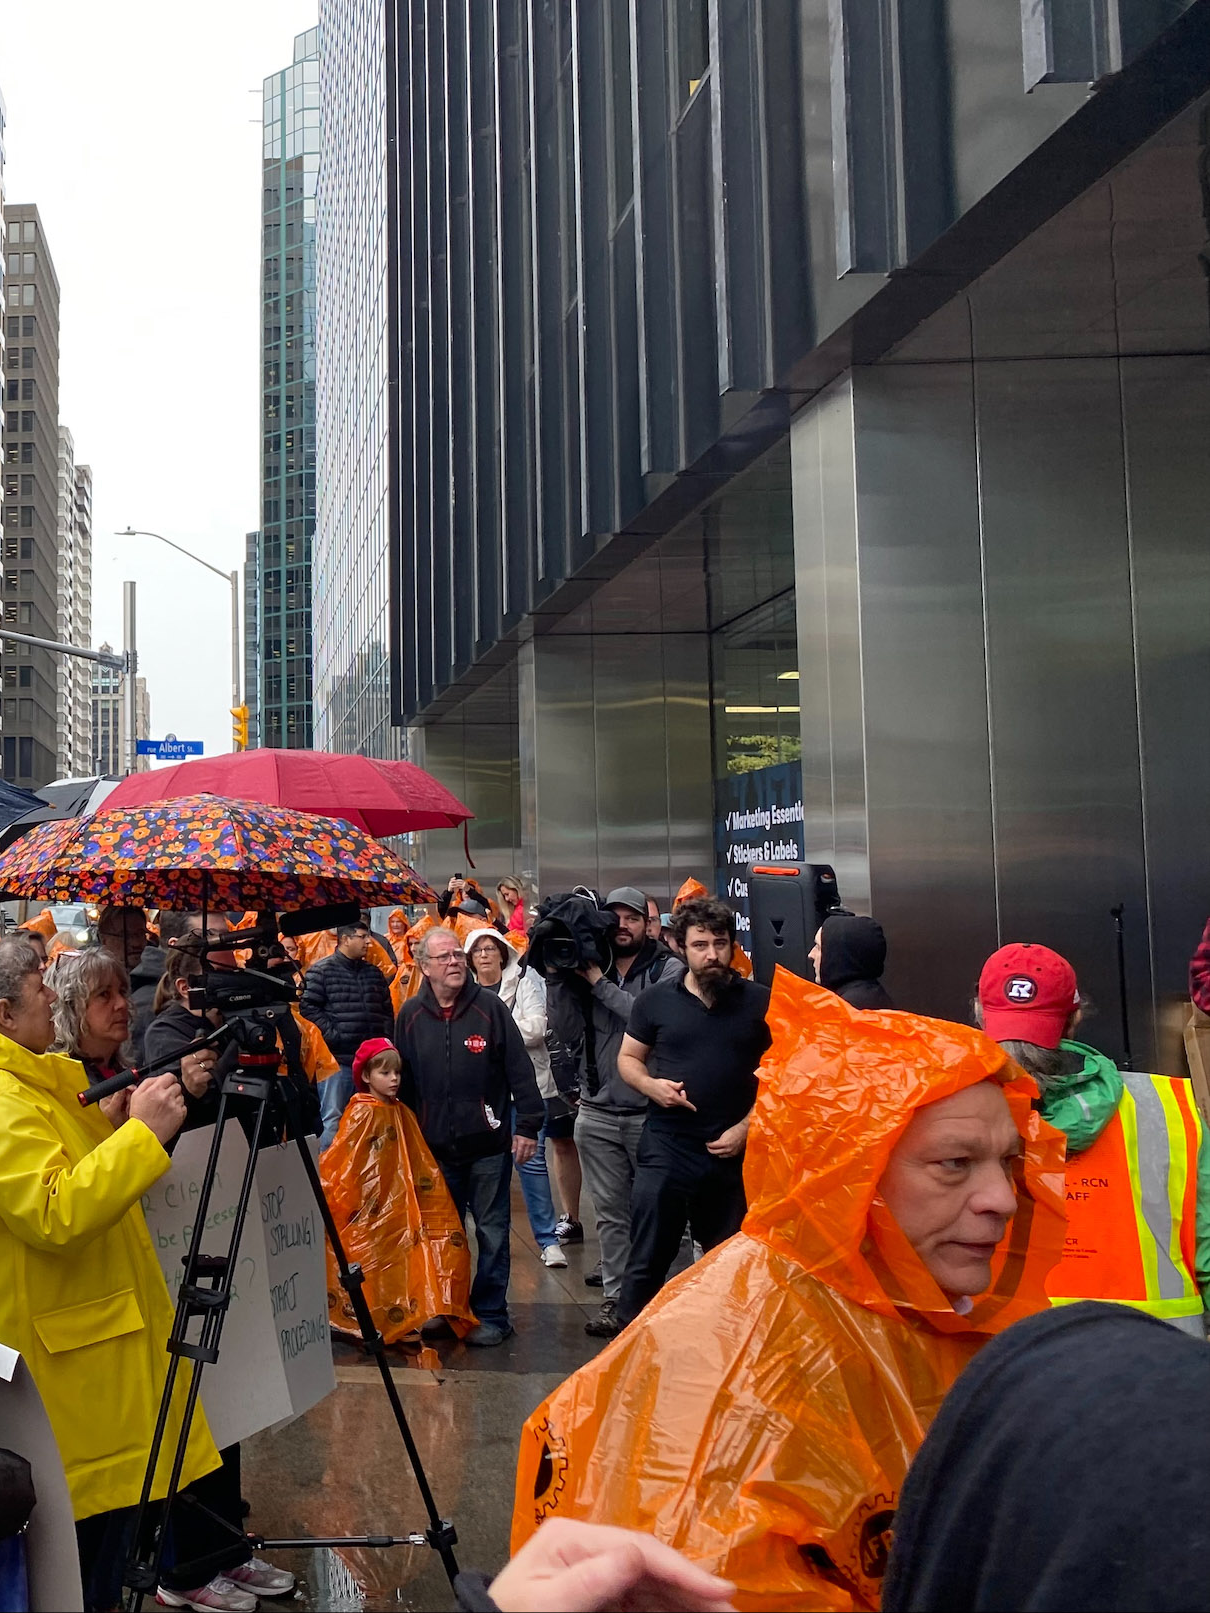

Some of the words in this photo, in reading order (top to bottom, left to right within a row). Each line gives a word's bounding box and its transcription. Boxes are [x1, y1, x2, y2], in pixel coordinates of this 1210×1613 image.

[159, 742, 185, 753] Albert
[732, 807, 771, 831] Marketing
[733, 843, 764, 864] Stickers
[764, 841, 770, 861] &
[770, 838, 799, 861] Labels
[229, 994, 251, 1002] Canon
[1081, 1178, 1109, 1188] RCN
[261, 1185, 286, 1223] STOP
